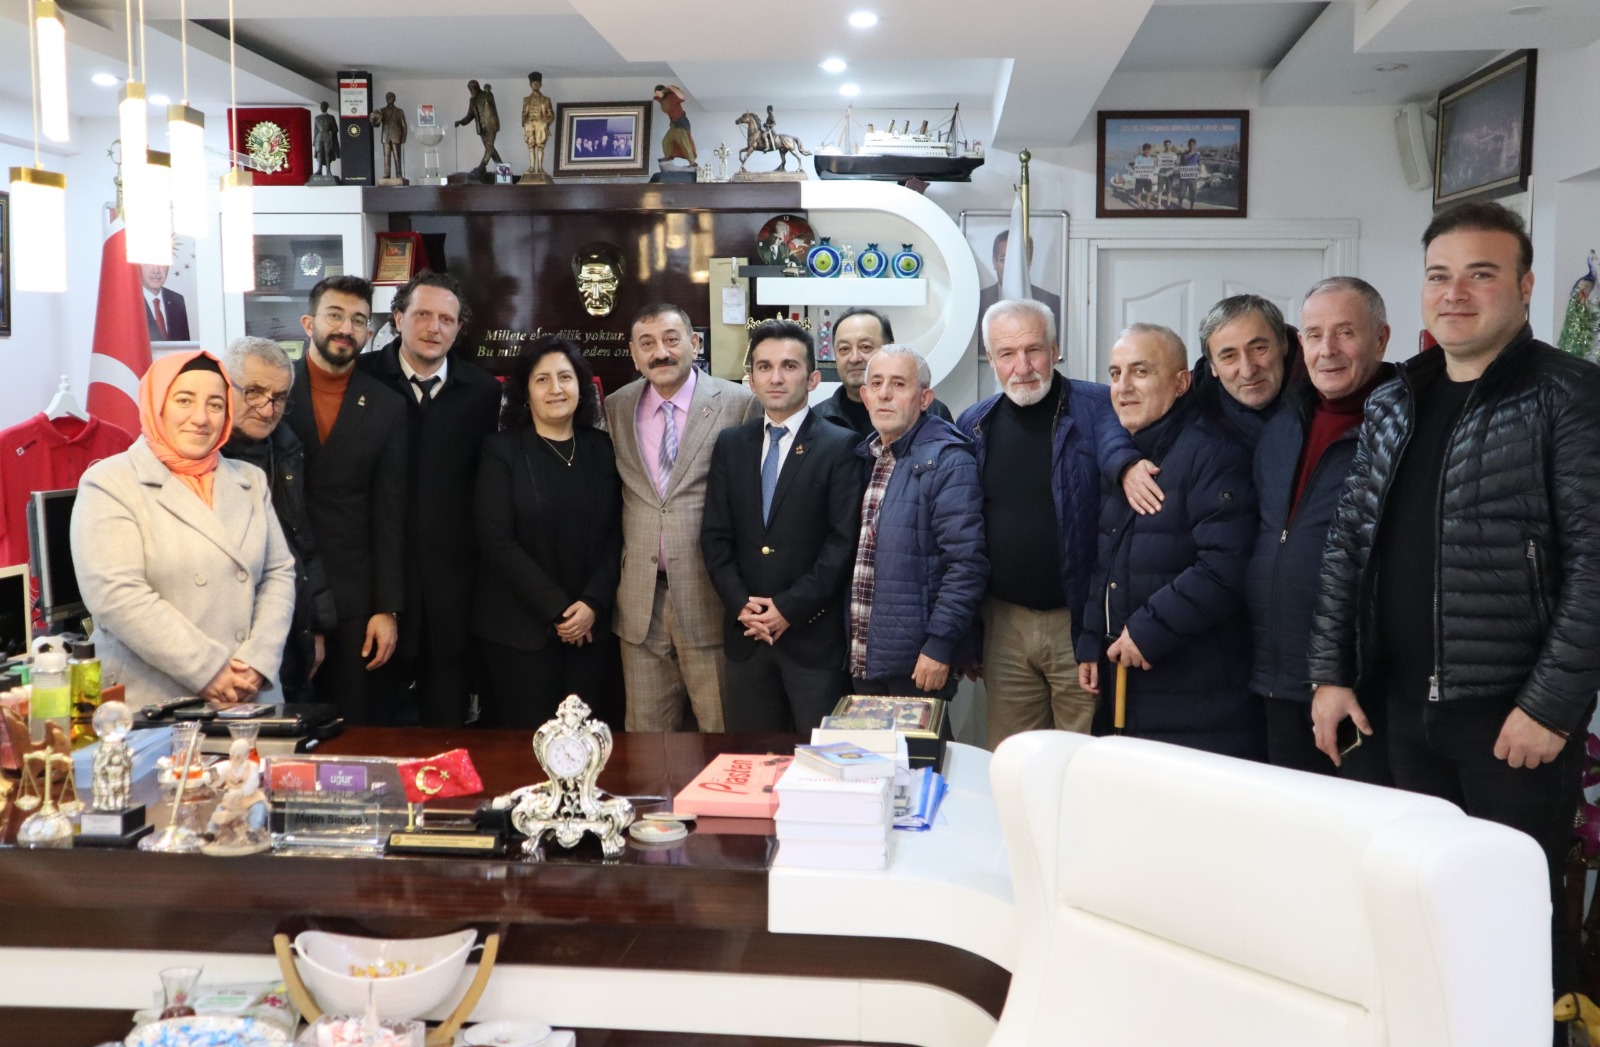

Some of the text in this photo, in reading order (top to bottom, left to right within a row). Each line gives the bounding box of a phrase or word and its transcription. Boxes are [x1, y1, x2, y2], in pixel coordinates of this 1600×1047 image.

[485, 329, 527, 341] Millete
[583, 329, 625, 343] yoktur.
[477, 345, 494, 357] Bu
[582, 345, 610, 357] eden
[295, 813, 324, 824] Metin
